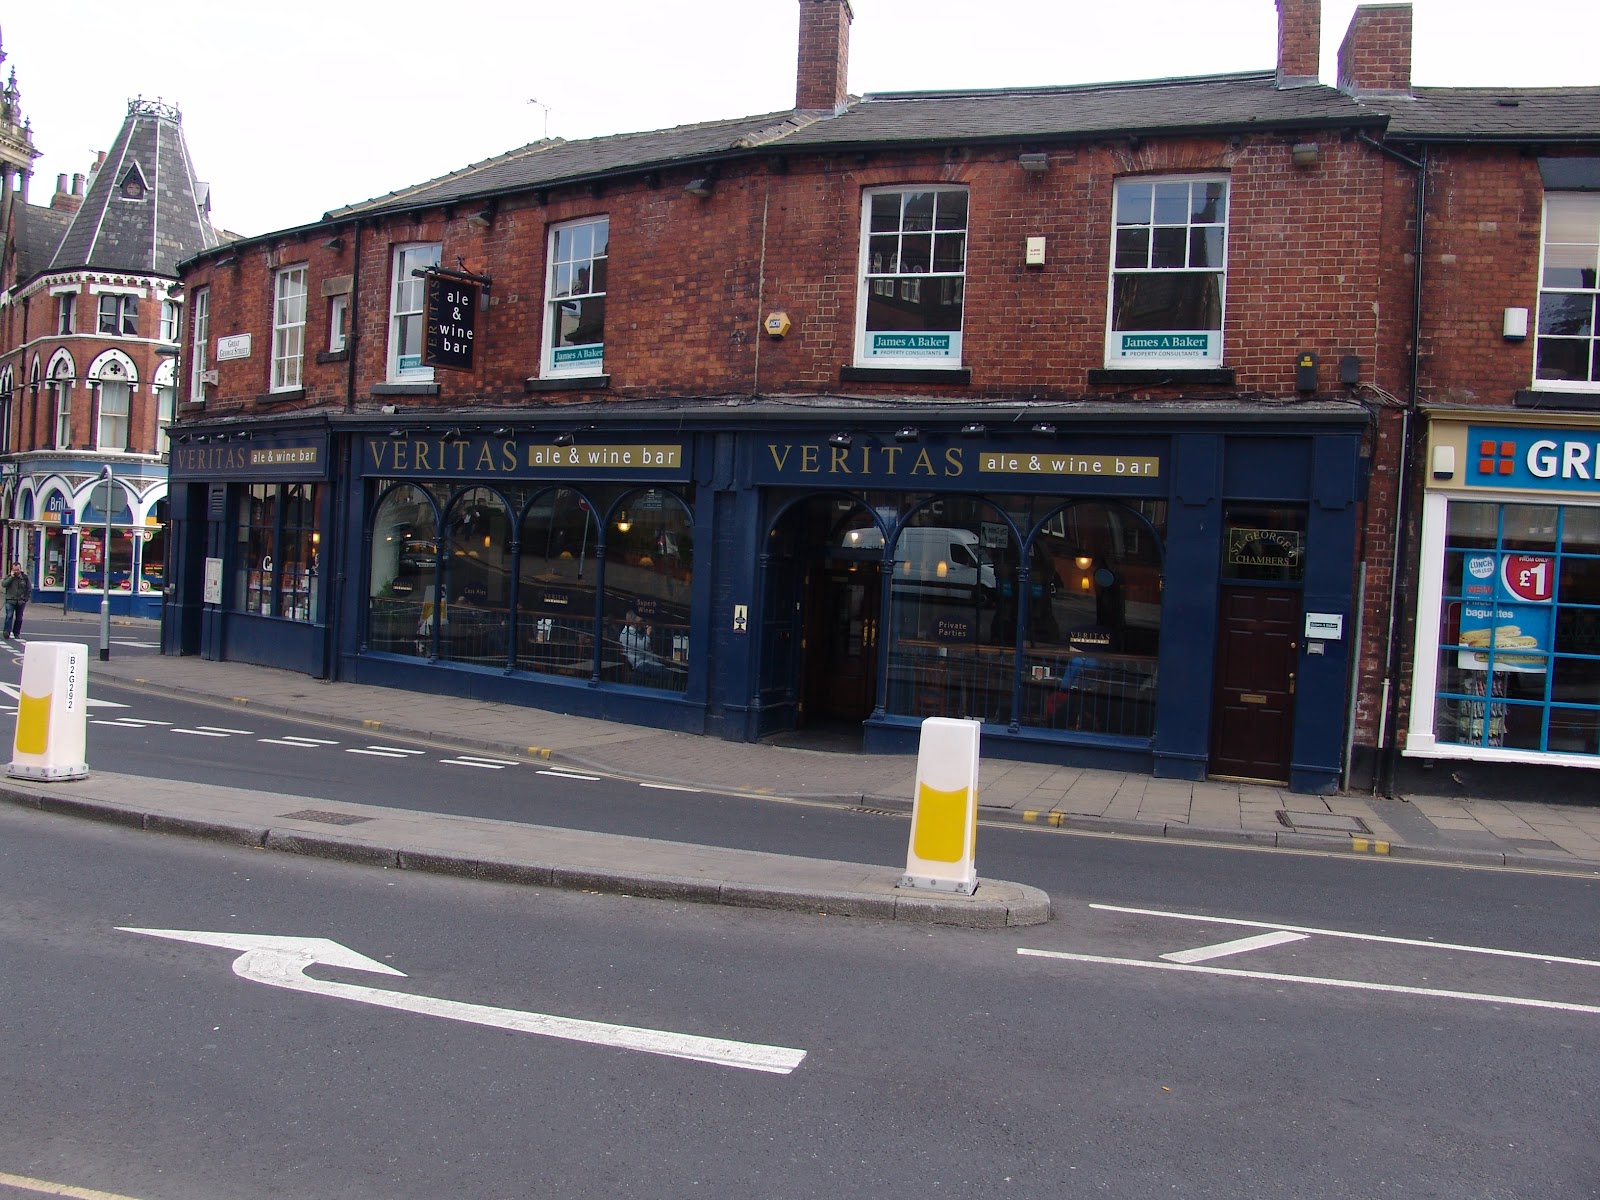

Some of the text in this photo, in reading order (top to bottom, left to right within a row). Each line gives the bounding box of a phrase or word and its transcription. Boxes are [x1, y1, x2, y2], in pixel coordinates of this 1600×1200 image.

[447, 291, 469, 306] ale
[427, 280, 440, 360] VERITAS
[452, 306, 462, 321] &
[439, 324, 474, 340] wine
[443, 337, 468, 354] bar
[876, 337, 947, 347] James A Baker
[1124, 337, 1205, 348] James A Baker
[555, 348, 603, 361] James A Baker
[177, 447, 315, 469] VERITAS ale & wine bar
[368, 440, 675, 472] VERITAS ale & wine bar
[767, 444, 1152, 477] VERITAS ale & wine bar
[1235, 554, 1290, 565] CHAMBERS
[1470, 559, 1493, 569] LUNCH
[1519, 562, 1546, 596] £1
[1466, 584, 1494, 594] NEW
[637, 606, 655, 614] Wines
[938, 620, 967, 630] Private
[938, 628, 967, 637] Parties
[1070, 631, 1111, 640] VERITAS
[68, 656, 76, 709] B2G292
